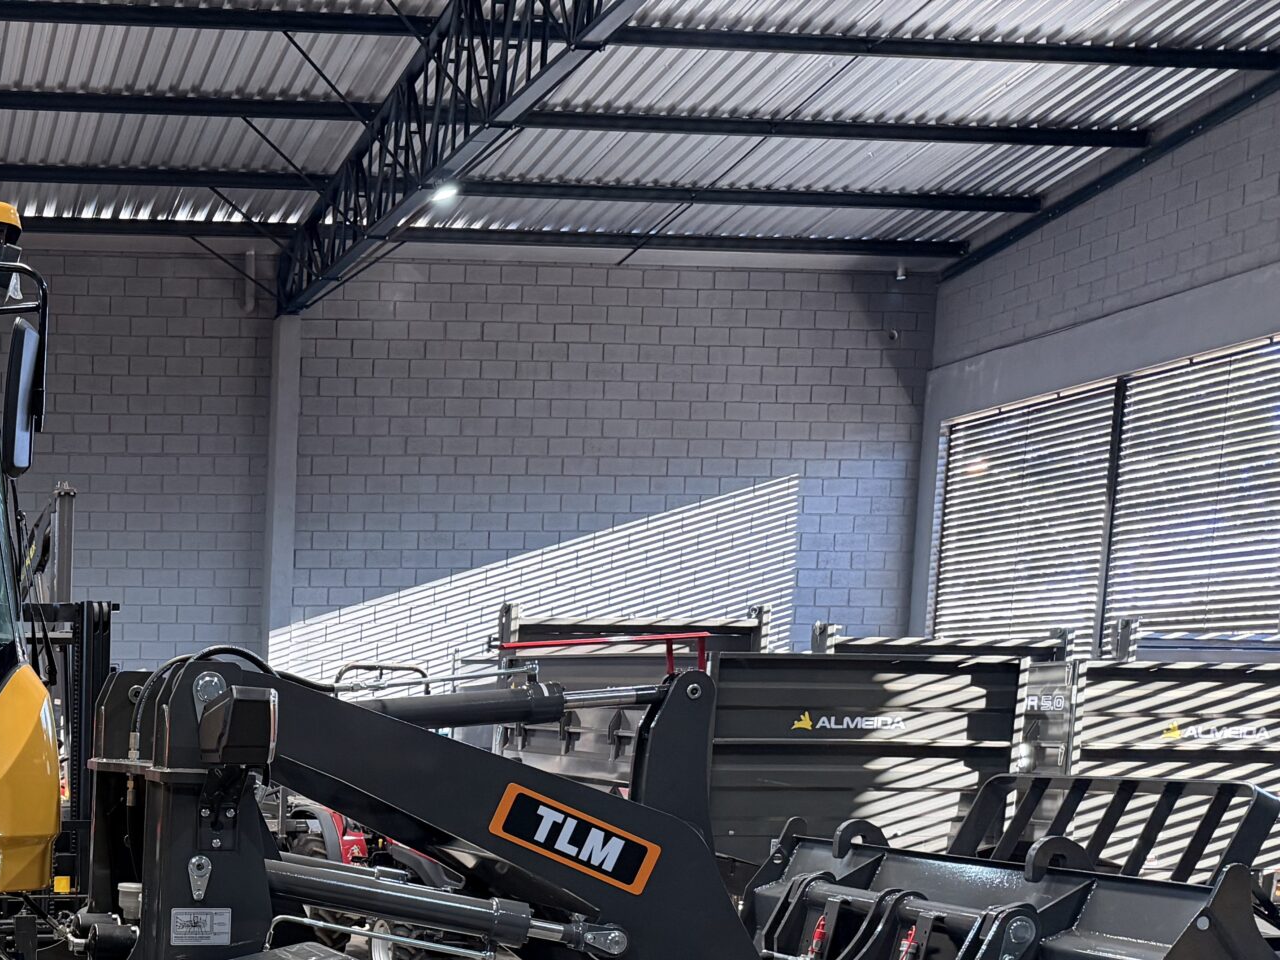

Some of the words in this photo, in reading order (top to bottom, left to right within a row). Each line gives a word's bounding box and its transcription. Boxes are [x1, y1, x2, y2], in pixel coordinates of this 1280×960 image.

[815, 715, 906, 730] ALMEIDA
[1183, 725, 1270, 739] ALMEIDA
[533, 804, 626, 873] TLM
